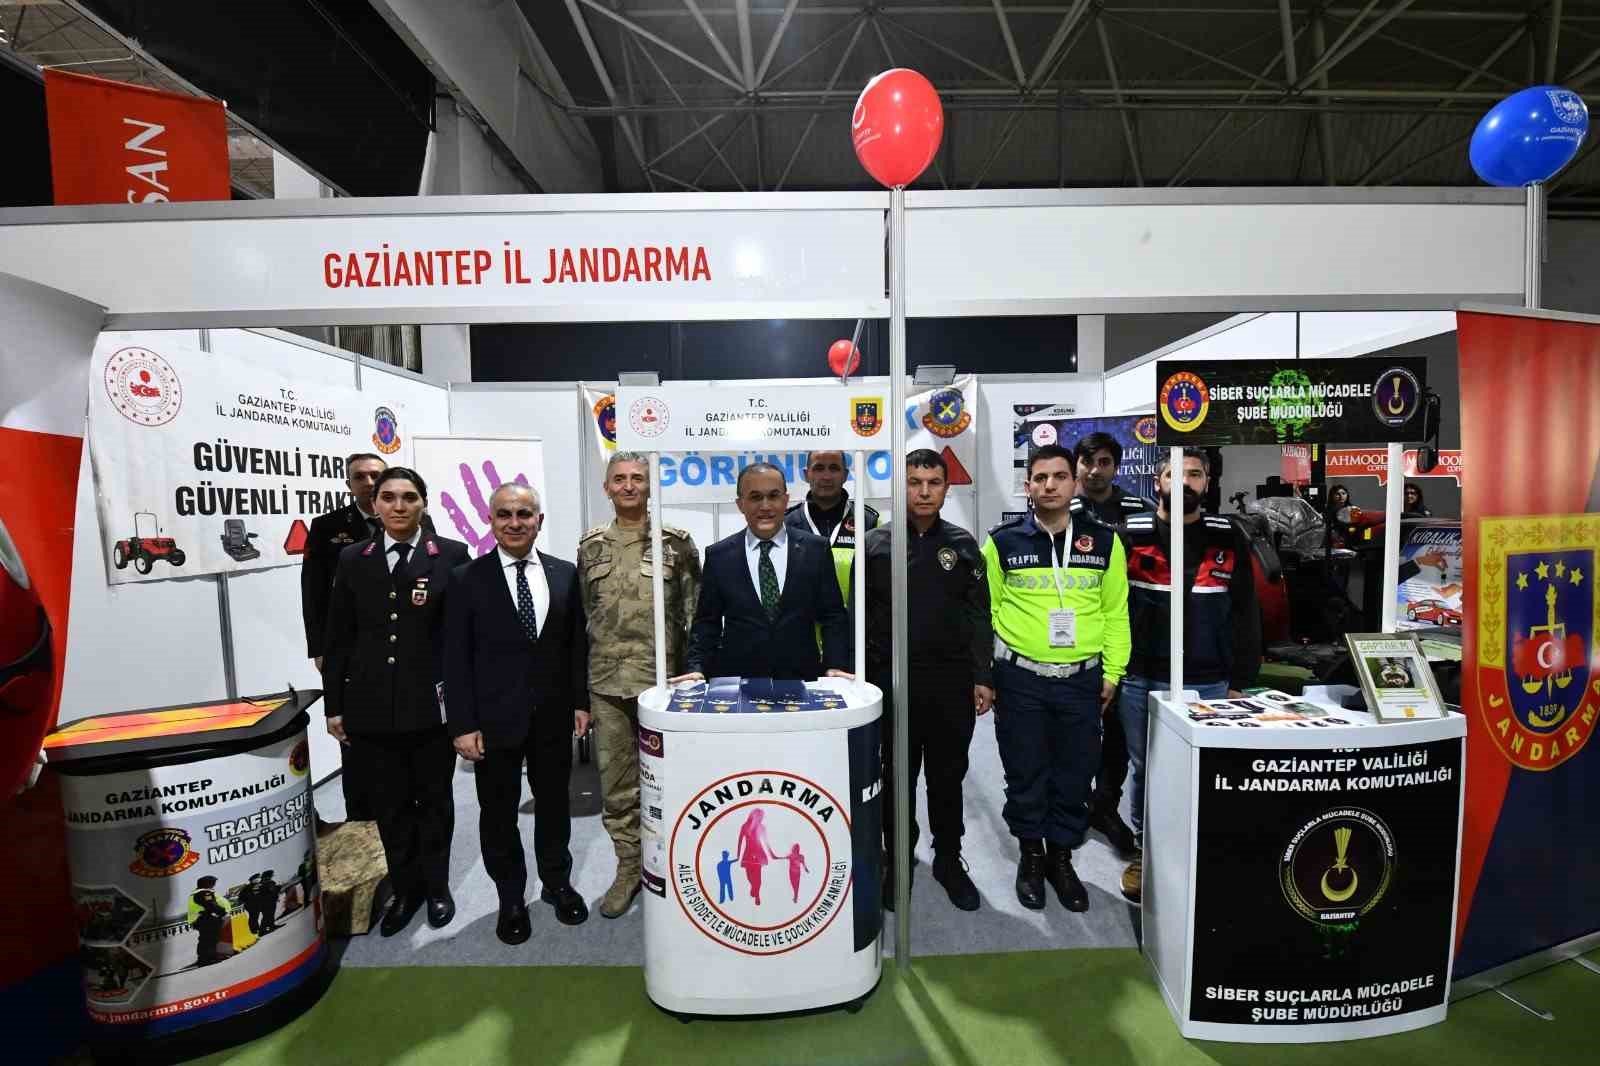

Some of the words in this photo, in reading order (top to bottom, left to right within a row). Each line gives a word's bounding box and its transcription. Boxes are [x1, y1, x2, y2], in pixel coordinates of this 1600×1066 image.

[323, 243, 493, 288] GAZİANTEP
[503, 241, 532, 284] İL
[541, 246, 712, 284] JANDARMA
[237, 393, 297, 413] GAZİANTEP
[749, 398, 768, 408] T.C.
[1209, 384, 1244, 401] SİBER
[1246, 384, 1306, 404] SUÇLARLA
[1309, 382, 1372, 398] MÜCADELE
[215, 402, 227, 417] İL
[229, 407, 290, 427] JANDARMA
[291, 417, 351, 436] KOMUTANLIĞI
[767, 410, 810, 423] VALİLİĞİ
[1237, 406, 1268, 424] ŞUBE
[1270, 402, 1344, 419] MÜDÜRLÜĞÜ
[685, 425, 695, 437] İL
[193, 438, 302, 477] GÜVENLİ
[175, 481, 289, 517] GÜVENLİ
[1007, 554, 1040, 567] TRAFİK
[1252, 757, 1358, 773] GAZİANTEP
[1362, 750, 1428, 771] VALİLİĞİ
[105, 778, 213, 805] GAZİANTEP
[1215, 774, 1233, 791] İL
[1238, 777, 1342, 792] JANDARMA
[1346, 767, 1452, 791] KOMUTANLIĞI
[161, 773, 286, 815] KOMUTANLIĞI
[687, 778, 835, 830] JANDARMA
[204, 805, 283, 843] TRAFİK
[687, 895, 726, 932] ŞİDDETLE
[722, 924, 770, 947] MÜCADELE
[771, 932, 784, 945] VE
[784, 916, 816, 945] ÇOCUK
[811, 898, 834, 924] KISIM
[1205, 984, 1259, 1001] SİBER
[1264, 988, 1353, 1006] SUÇLARLA
[1357, 973, 1435, 1000] MÜCADELE
[1251, 1006, 1298, 1023] ŞUBE
[1303, 996, 1403, 1020] MÜDÜRLÜĞÜ
